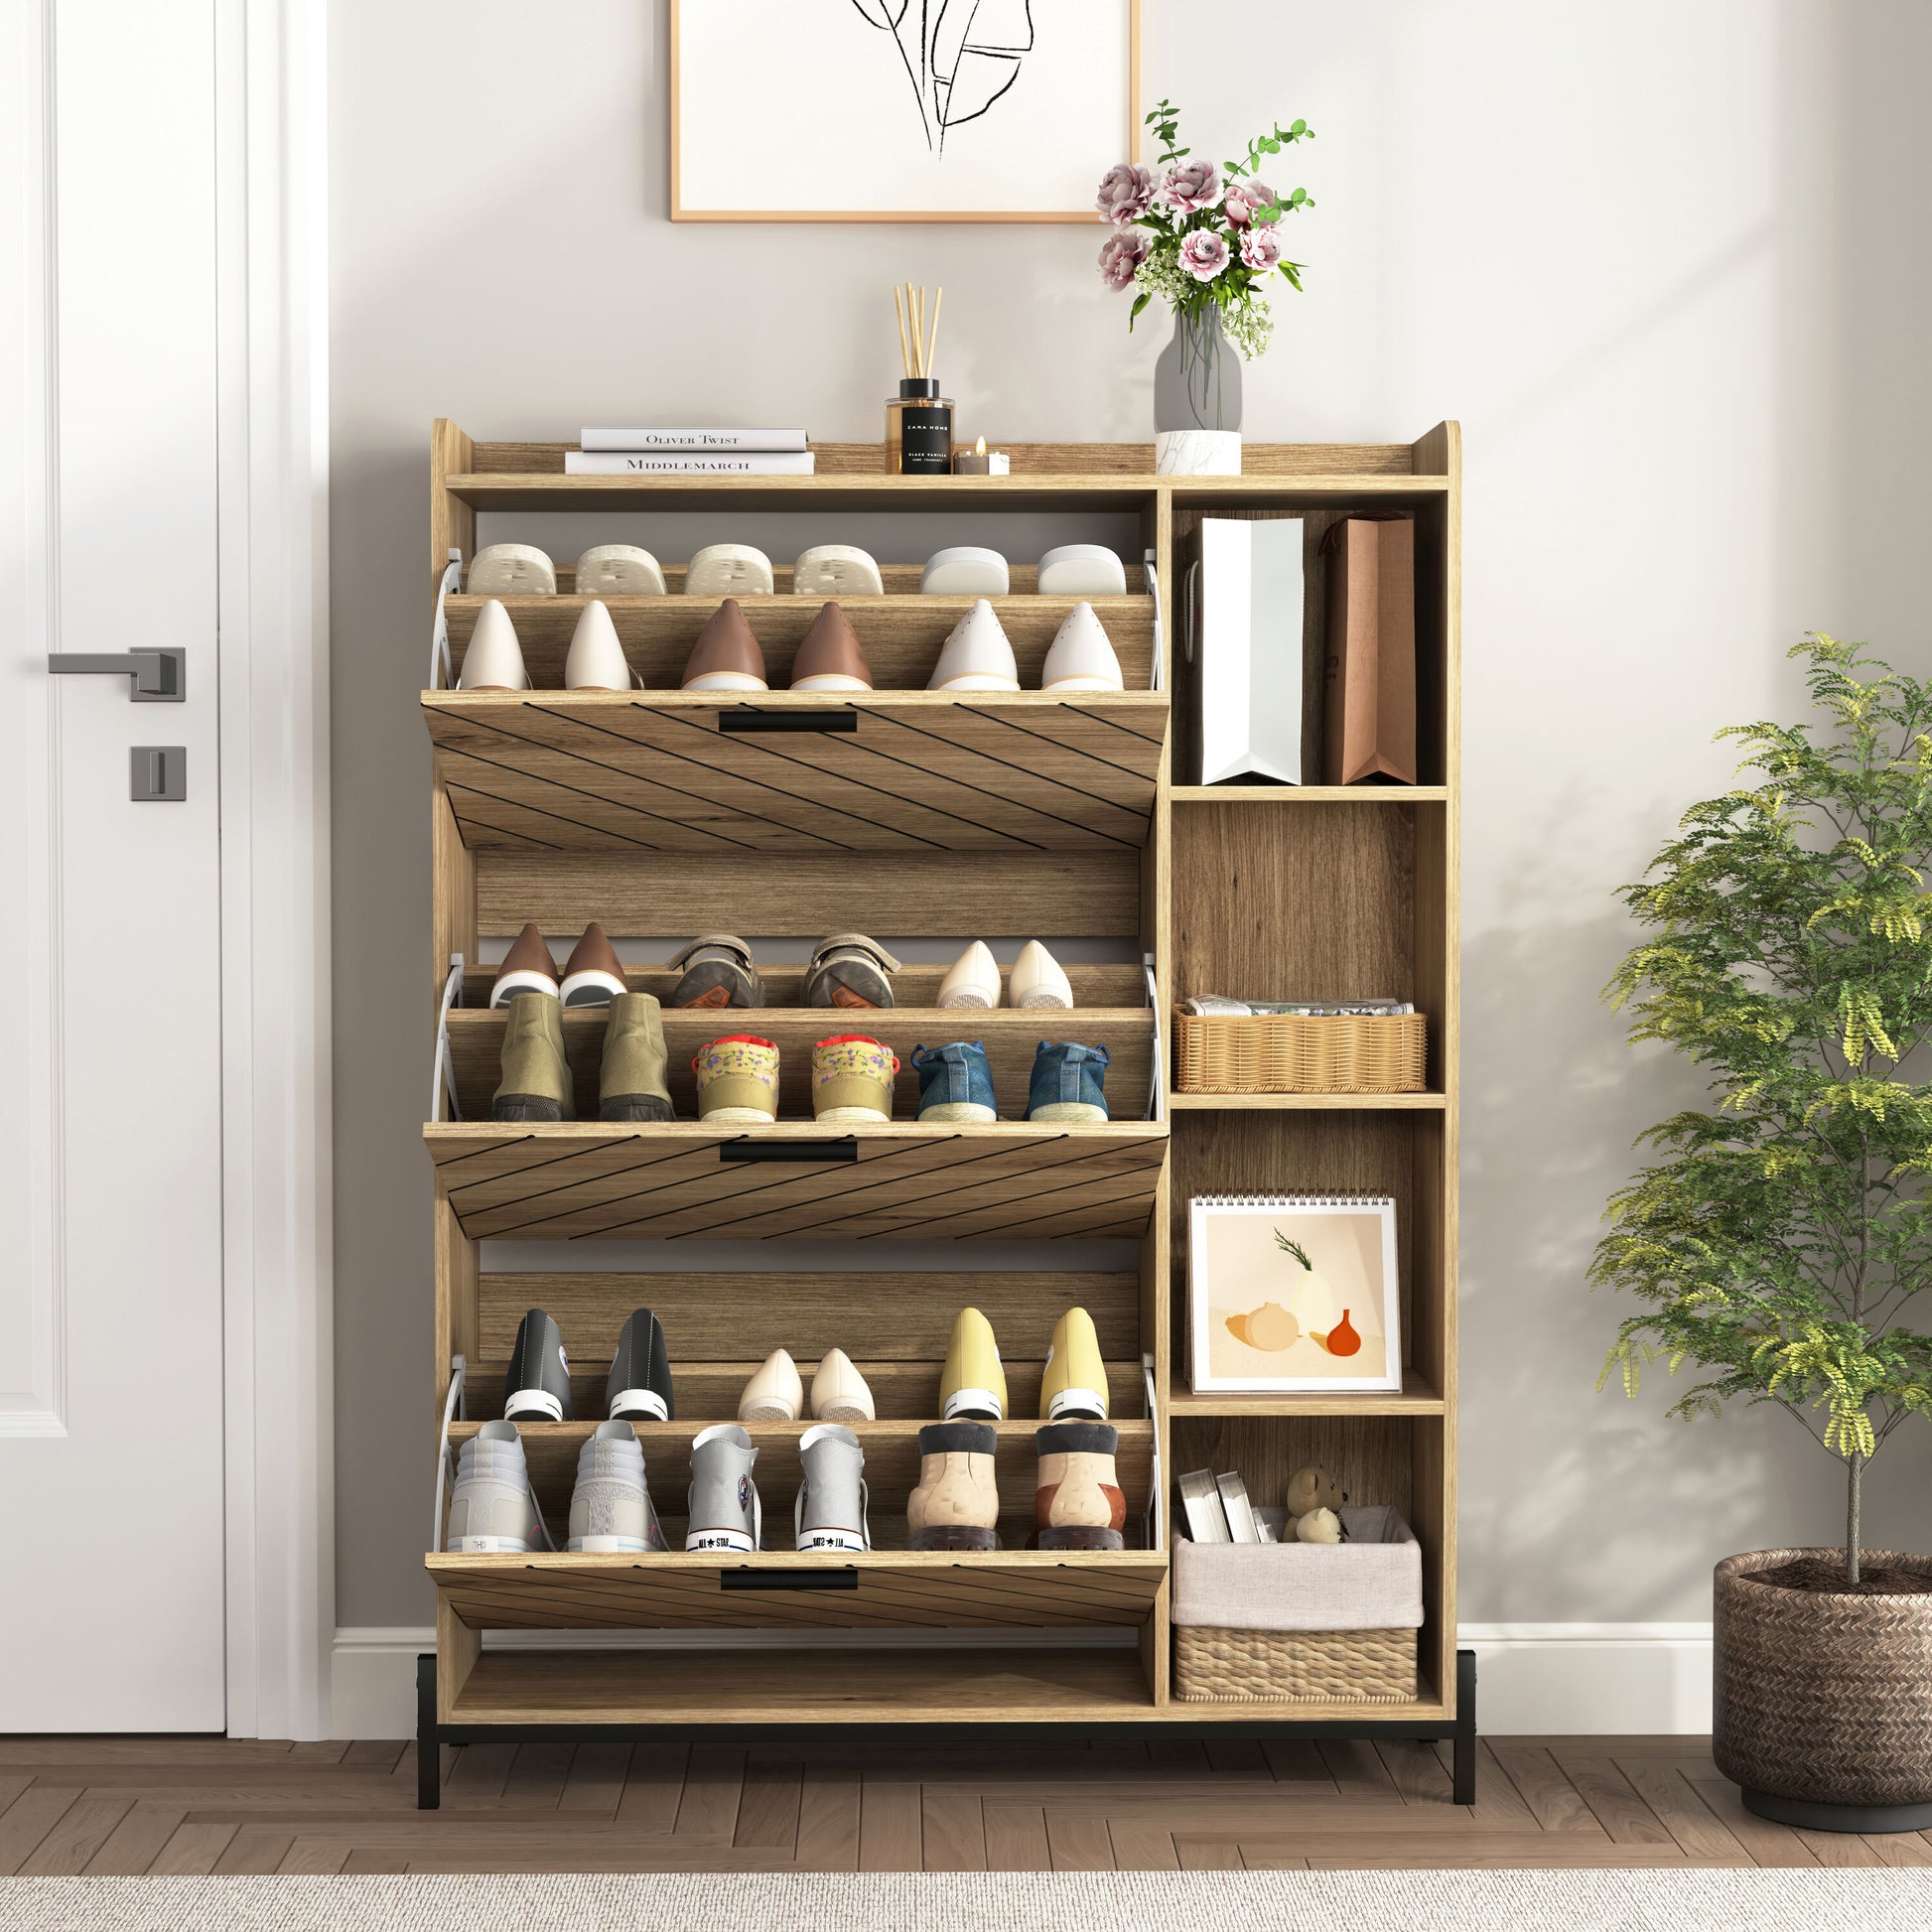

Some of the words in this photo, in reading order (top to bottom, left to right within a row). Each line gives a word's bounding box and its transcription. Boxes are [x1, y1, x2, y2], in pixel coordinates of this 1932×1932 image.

[645, 435, 695, 445] OLIVER
[699, 435, 740, 445] TWIST
[626, 459, 750, 470] MIDDLEMARCH
[698, 1538, 707, 1549] ALL
[716, 1537, 730, 1548] STAR
